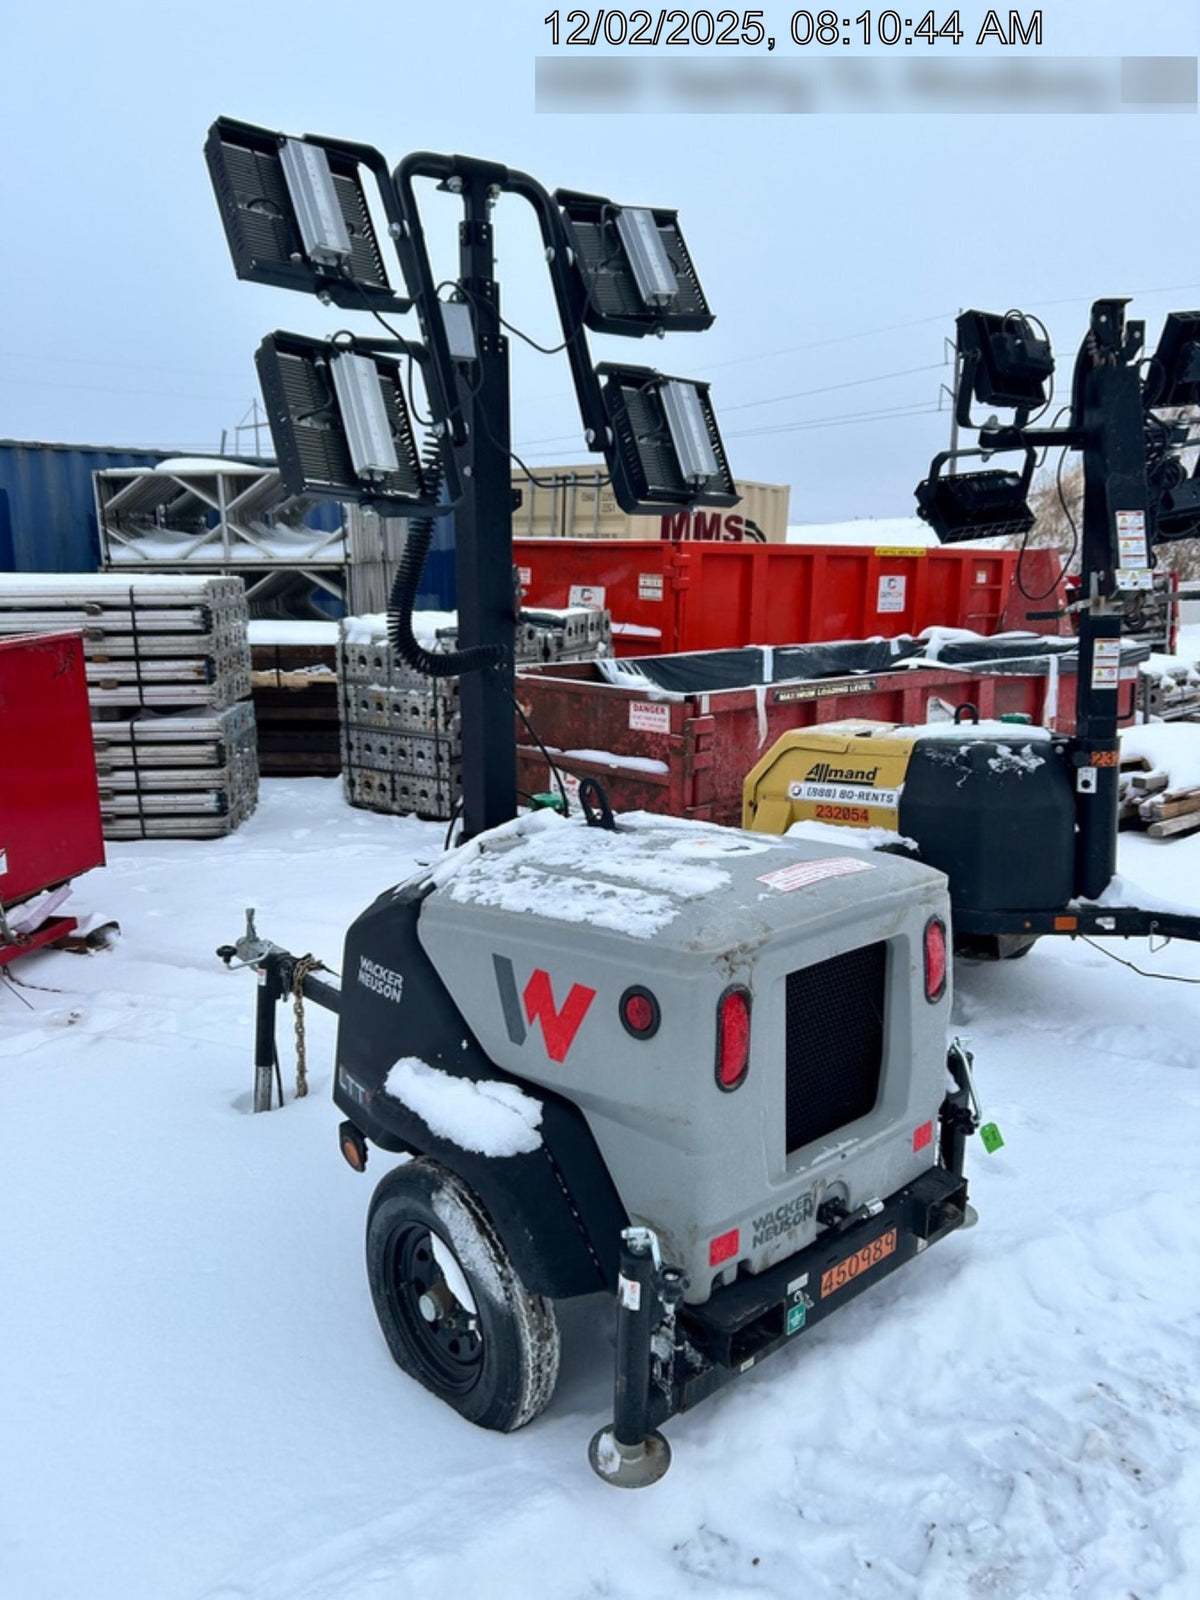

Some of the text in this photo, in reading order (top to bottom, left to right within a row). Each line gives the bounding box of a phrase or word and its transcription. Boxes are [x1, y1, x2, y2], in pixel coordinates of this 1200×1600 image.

[660, 511, 743, 542] MMS
[817, 686, 848, 697] LOADING
[850, 682, 871, 693] LEVEL
[632, 703, 666, 715] DANGER
[1092, 752, 1118, 766] 23
[805, 763, 878, 782] Allmand
[806, 786, 837, 799] (888)
[815, 805, 869, 822] 232054
[360, 954, 404, 989] WACKER
[357, 968, 402, 1003] NEUSON
[752, 1191, 814, 1233] WACKER
[752, 1204, 814, 1250] NEUSON
[822, 1231, 896, 1293] 450989
